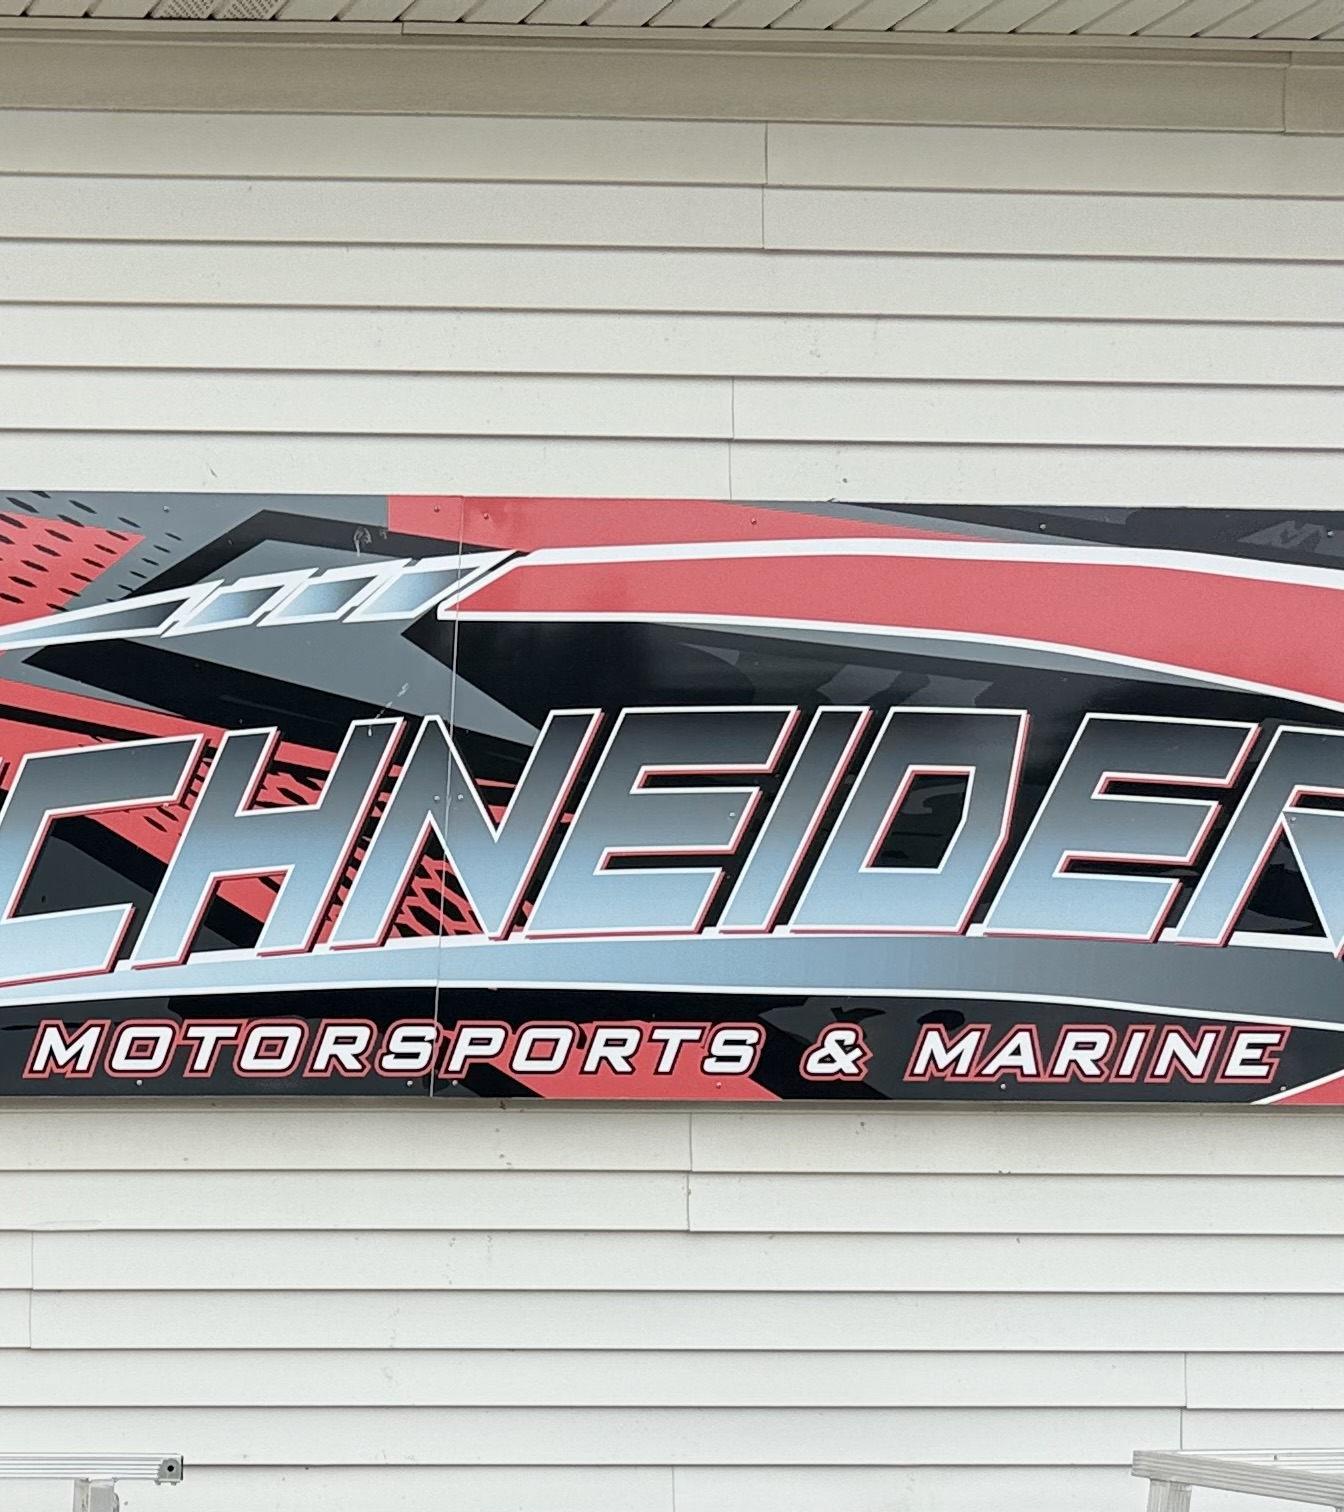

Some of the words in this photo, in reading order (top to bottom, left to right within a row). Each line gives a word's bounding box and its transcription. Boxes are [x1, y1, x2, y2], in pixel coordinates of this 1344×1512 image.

[24, 1019, 763, 1078] MOTORSPORTS
[801, 1023, 872, 1081] &
[904, 1024, 1290, 1083] MARINE
